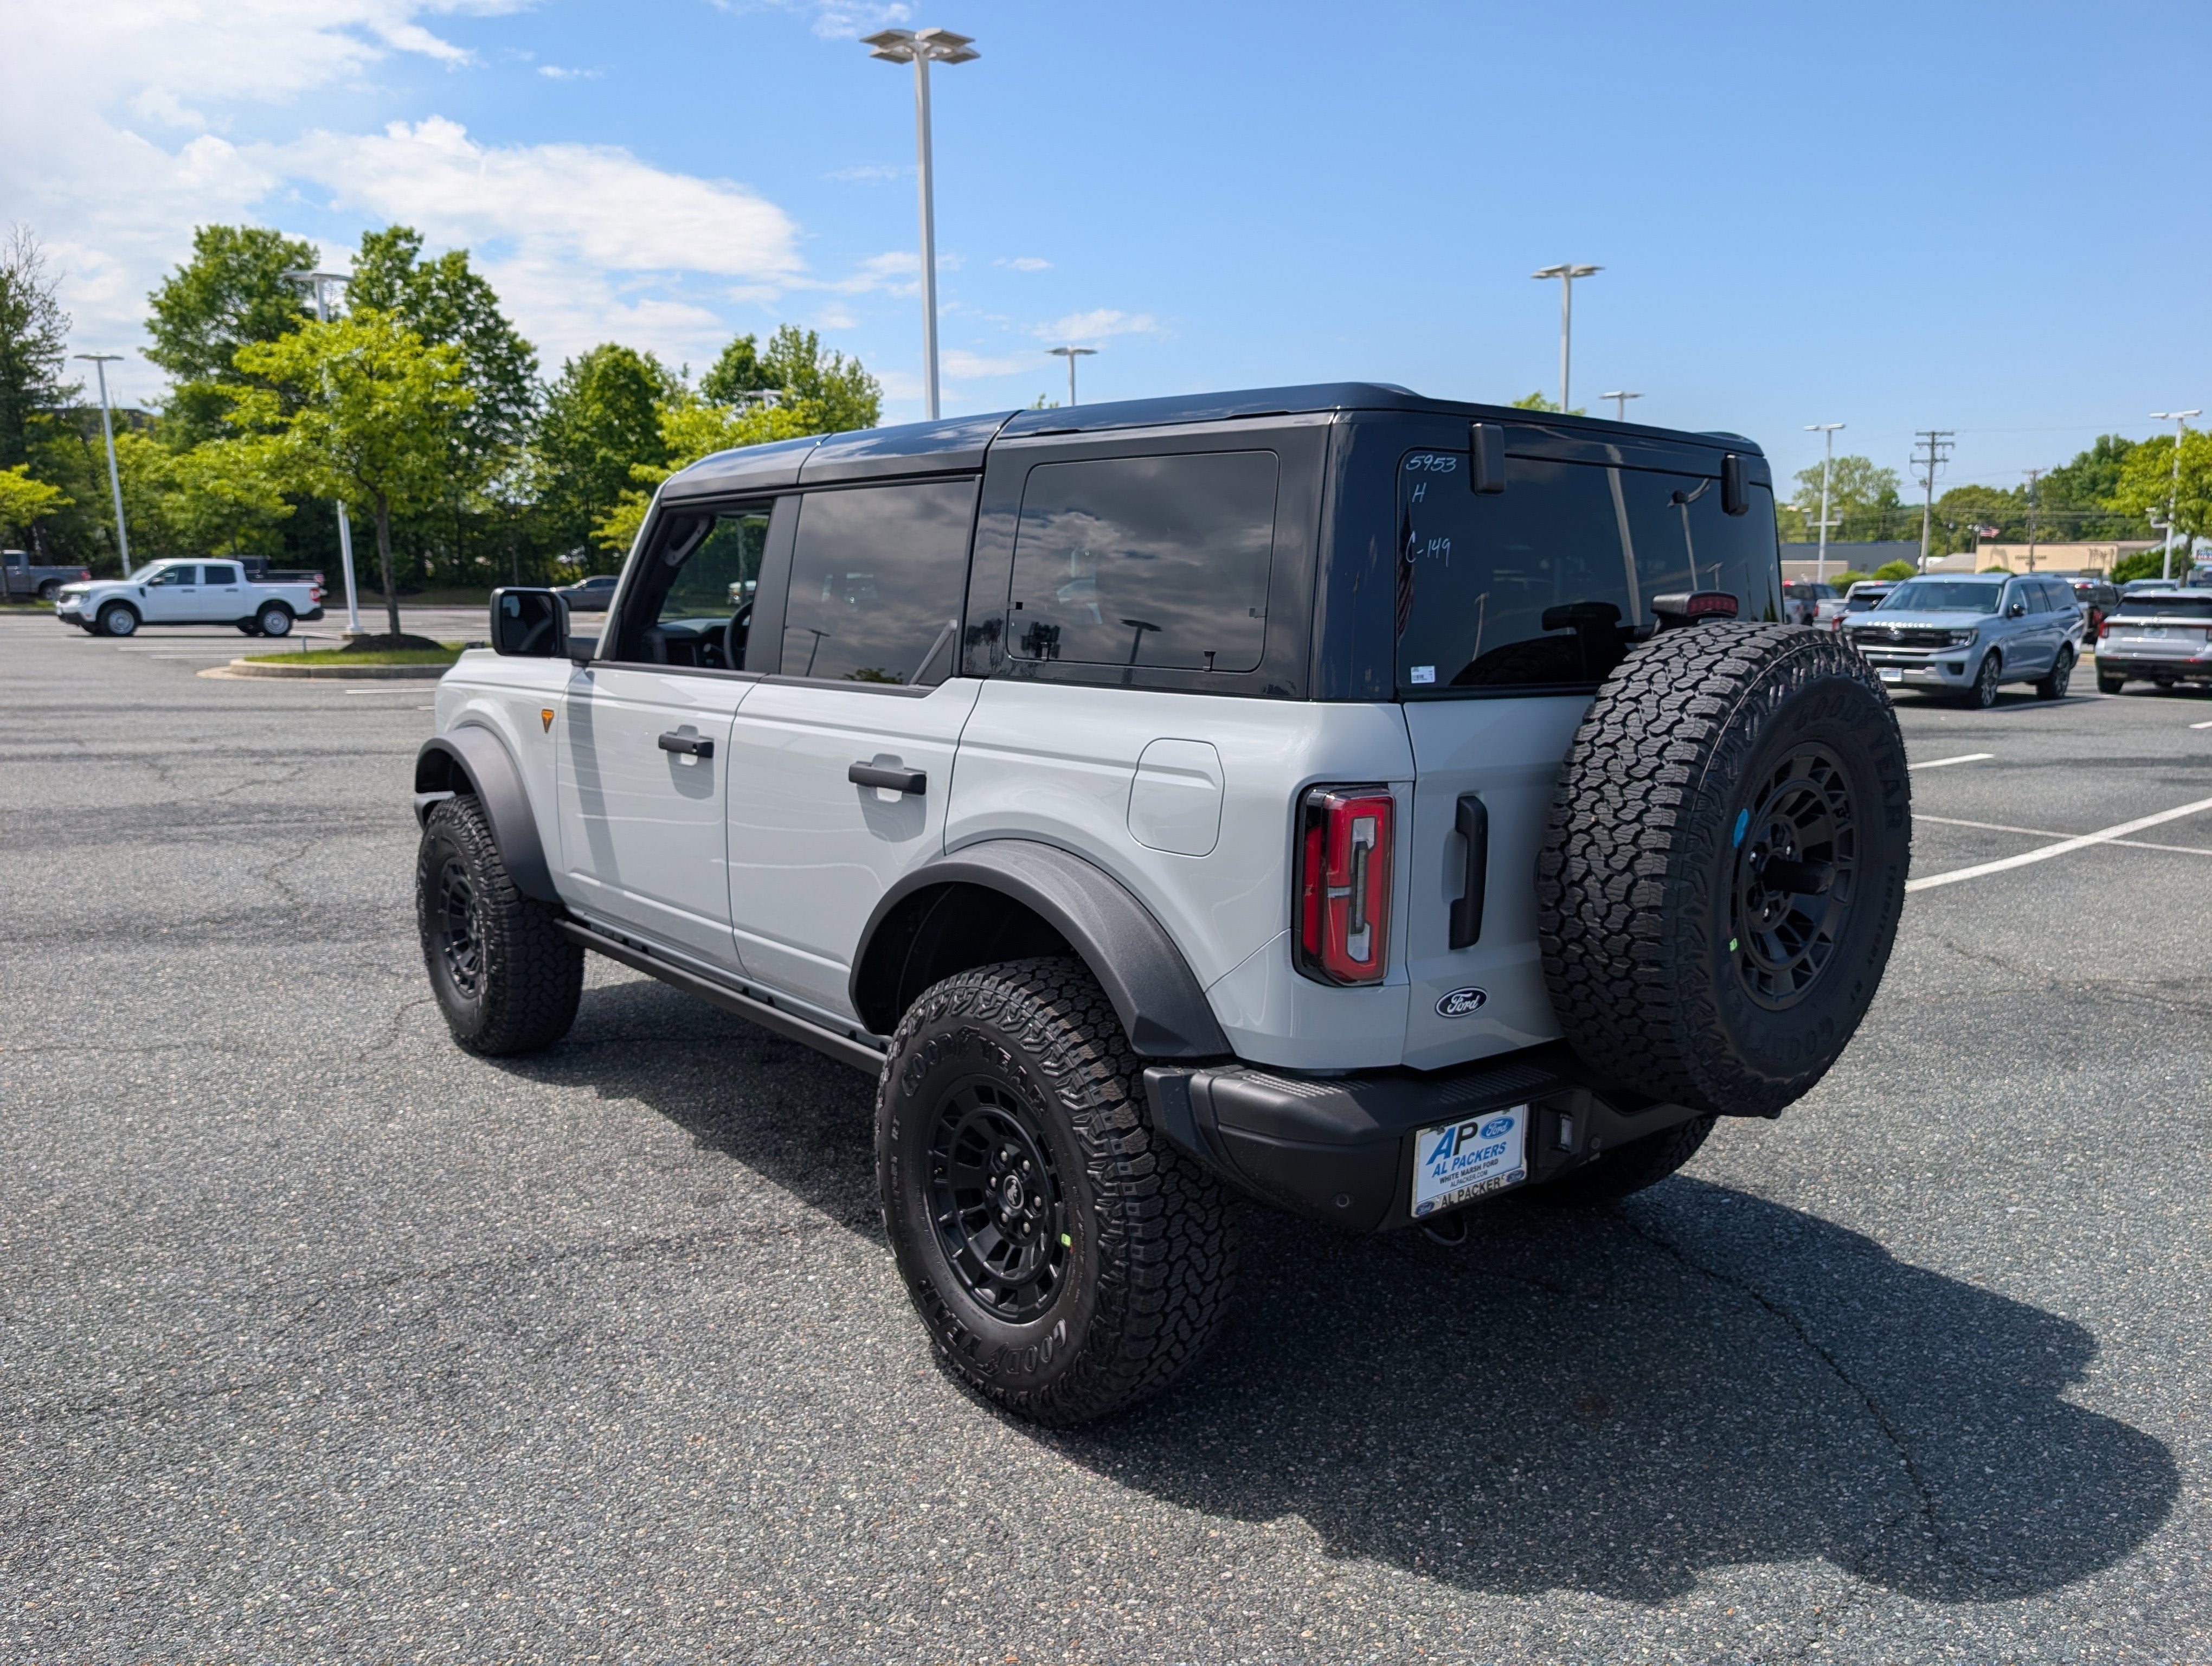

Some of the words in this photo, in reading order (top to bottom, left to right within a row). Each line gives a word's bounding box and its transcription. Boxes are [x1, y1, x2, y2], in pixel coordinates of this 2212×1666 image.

[1406, 454, 1456, 472] 5953
[1412, 482, 1427, 502] H
[1444, 991, 1483, 1015] Ford
[1426, 1121, 1478, 1165] AP
[1484, 1119, 1510, 1137] Ford
[1432, 1161, 1447, 1178] AL
[1451, 1142, 1507, 1171] PACKERS
[1439, 1172, 1459, 1184] WHITE
[1461, 1164, 1481, 1176] MARSH
[1483, 1158, 1499, 1169] FORD
[1450, 1170, 1488, 1188] ALPACKER.COM
[1441, 1194, 1456, 1208] AL
[1458, 1177, 1500, 1202] PACKER
